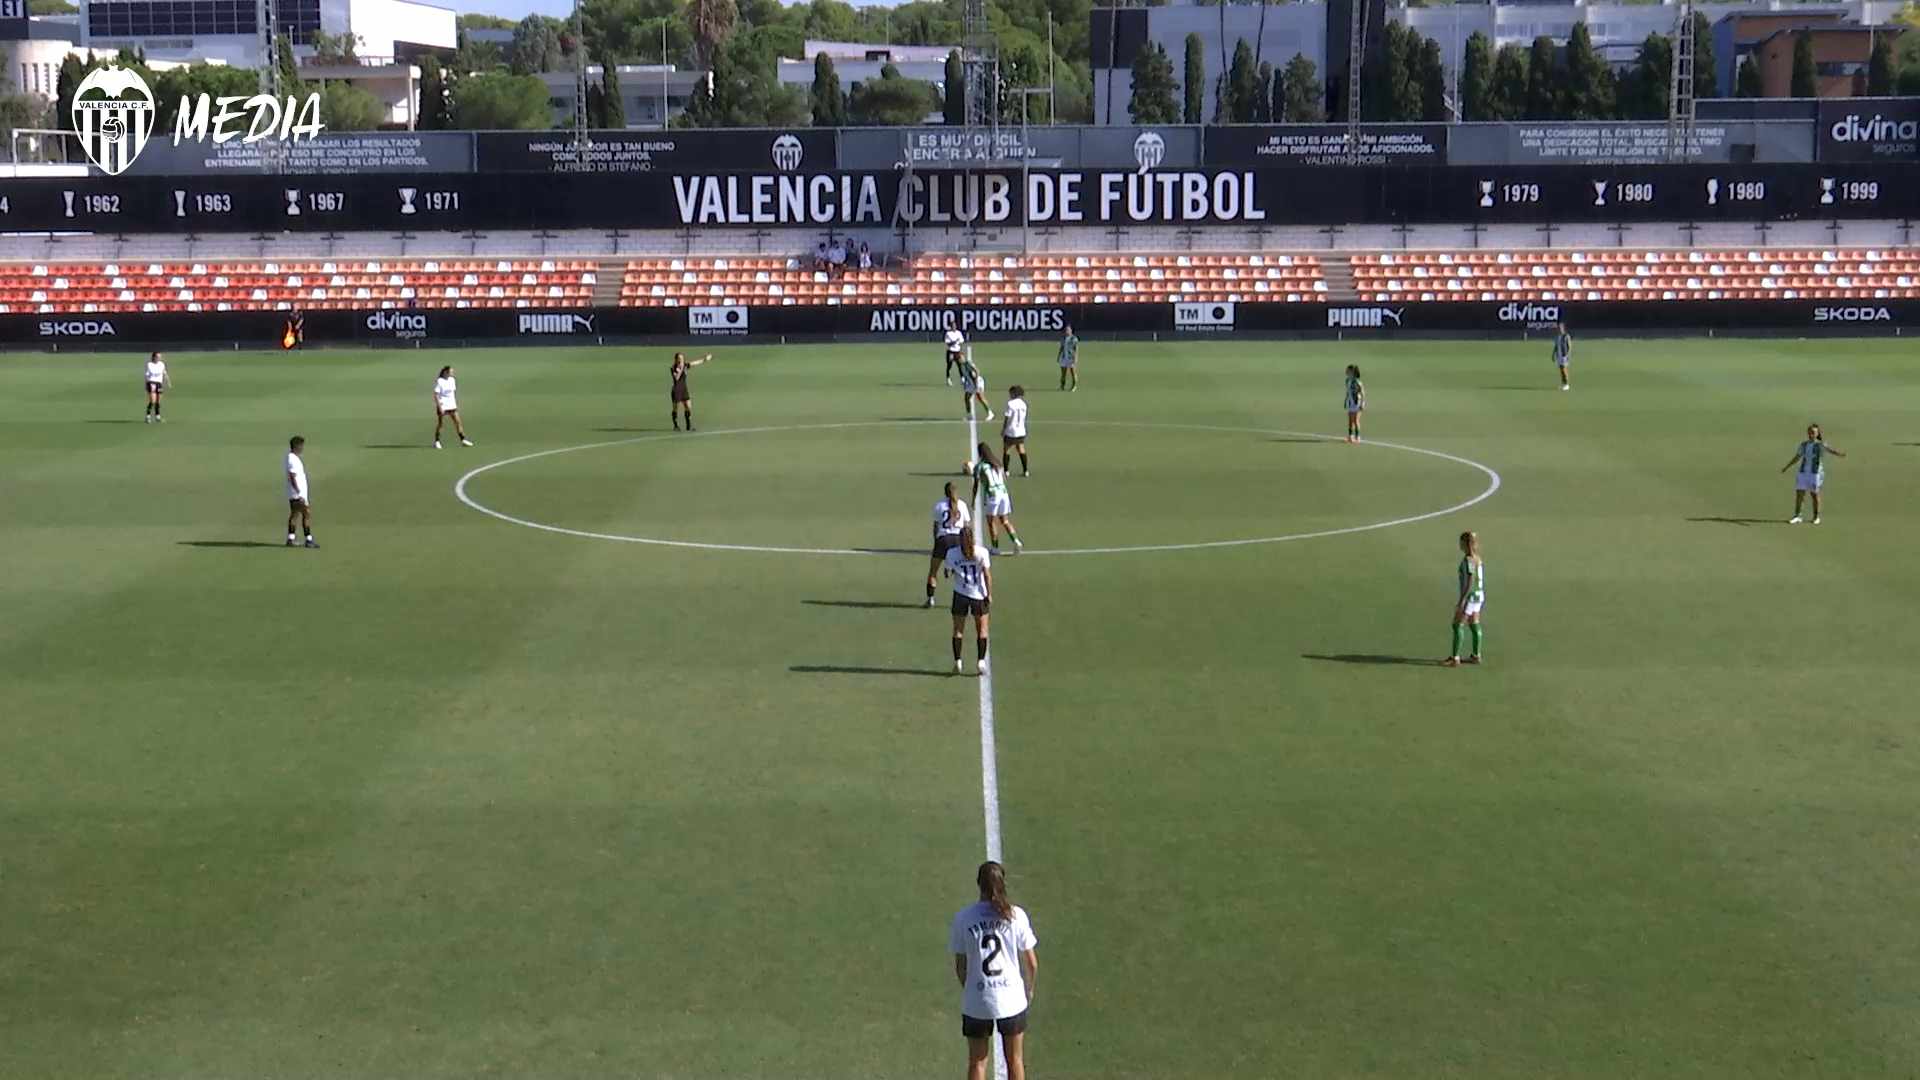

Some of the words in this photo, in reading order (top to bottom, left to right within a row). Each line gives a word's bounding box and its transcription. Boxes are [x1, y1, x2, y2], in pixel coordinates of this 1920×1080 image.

[1831, 114, 1917, 141] divina
[624, 141, 641, 151] TAN
[643, 141, 675, 151] BUENO
[919, 134, 937, 147] ES
[1281, 135, 1306, 145] RETO
[1873, 143, 1916, 156] seguros
[672, 174, 883, 224] VALENCIA
[899, 173, 1010, 223] CLUB
[1028, 173, 1083, 221] DE
[1100, 166, 1266, 221] FÚTBOL
[1503, 184, 1539, 202] 1979
[1616, 183, 1653, 202] 1980
[1728, 182, 1765, 201] 1980
[1841, 182, 1878, 201] 1999
[84, 195, 120, 214] 1962
[196, 194, 232, 213] 1963
[309, 193, 344, 212] 1967
[424, 192, 459, 211] 1971
[366, 311, 426, 330] divina
[693, 312, 713, 324] TM
[870, 310, 953, 332] ANTONIO
[962, 309, 1064, 331] PUCHADES
[1179, 308, 1199, 321] TM
[1327, 307, 1384, 327] PUMA
[1498, 302, 1559, 321] divina
[1814, 307, 1890, 320] SKODA
[39, 321, 116, 336] SKODA
[518, 313, 576, 334] PUMA
[981, 934, 1003, 977] 2
